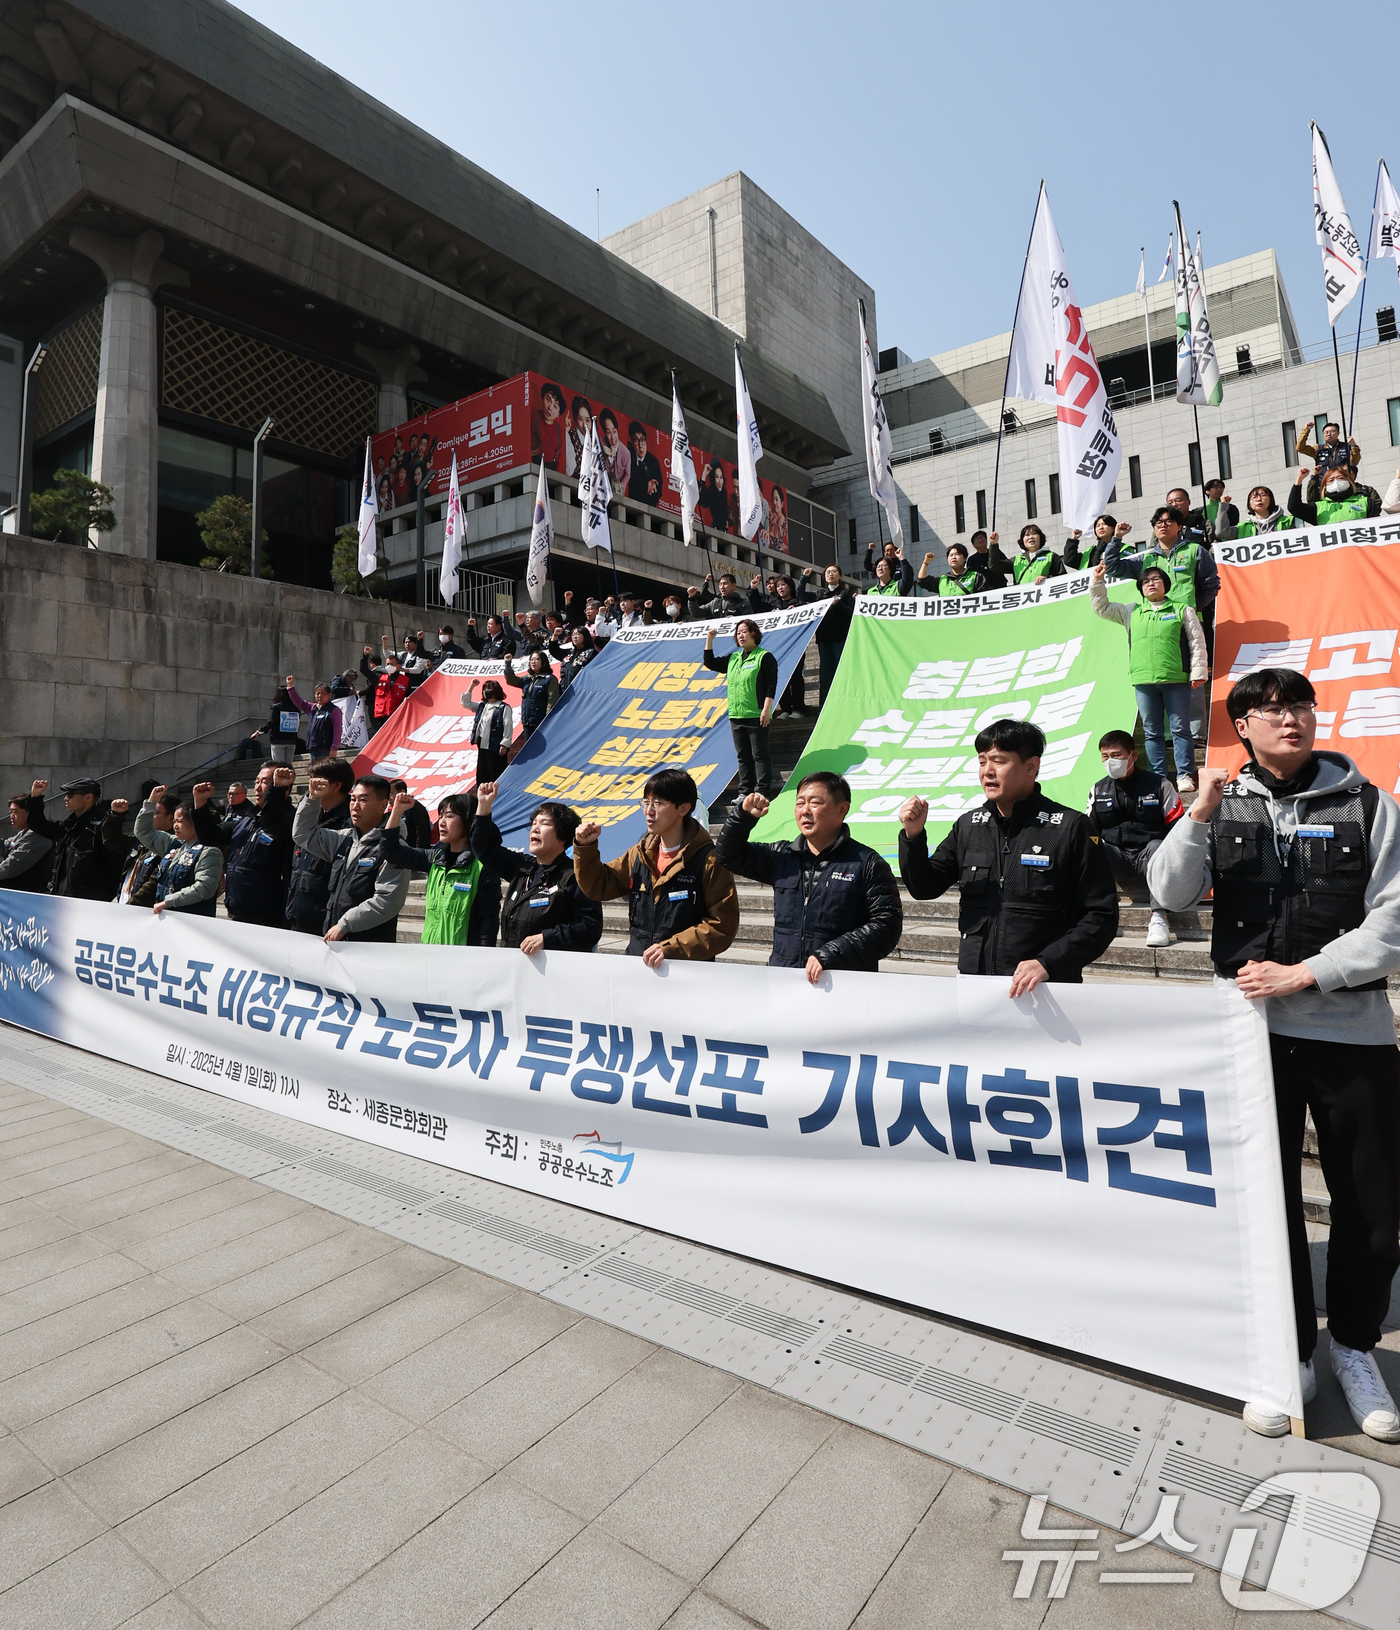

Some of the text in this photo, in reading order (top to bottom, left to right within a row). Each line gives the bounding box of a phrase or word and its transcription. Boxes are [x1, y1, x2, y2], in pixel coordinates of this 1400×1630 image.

[468, 404, 512, 448] 코믹
[1221, 533, 1310, 564] 2025년
[859, 601, 918, 617] 2025년
[924, 590, 1042, 617] 비정규노동자
[1048, 576, 1090, 599] 투쟁
[616, 630, 662, 642] 2025년
[442, 663, 478, 675] 2025년
[902, 635, 1084, 700] 충분한
[1036, 811, 1064, 825] 투쟁
[74, 938, 1217, 1208] 공공운수노조 비정규직 노동자 투쟁선포 기자회견
[166, 1043, 187, 1065] 일시
[190, 1050, 224, 1077] 2025년
[225, 1060, 243, 1082] 4월
[243, 1065, 277, 1093] 1일(화)
[280, 1075, 300, 1100] 11시
[327, 1088, 352, 1114] 장소
[362, 1098, 448, 1141] 세종문화회관
[485, 1128, 519, 1161] 주최
[540, 1139, 563, 1154] 민주노총
[538, 1150, 614, 1188] 공공운수노조
